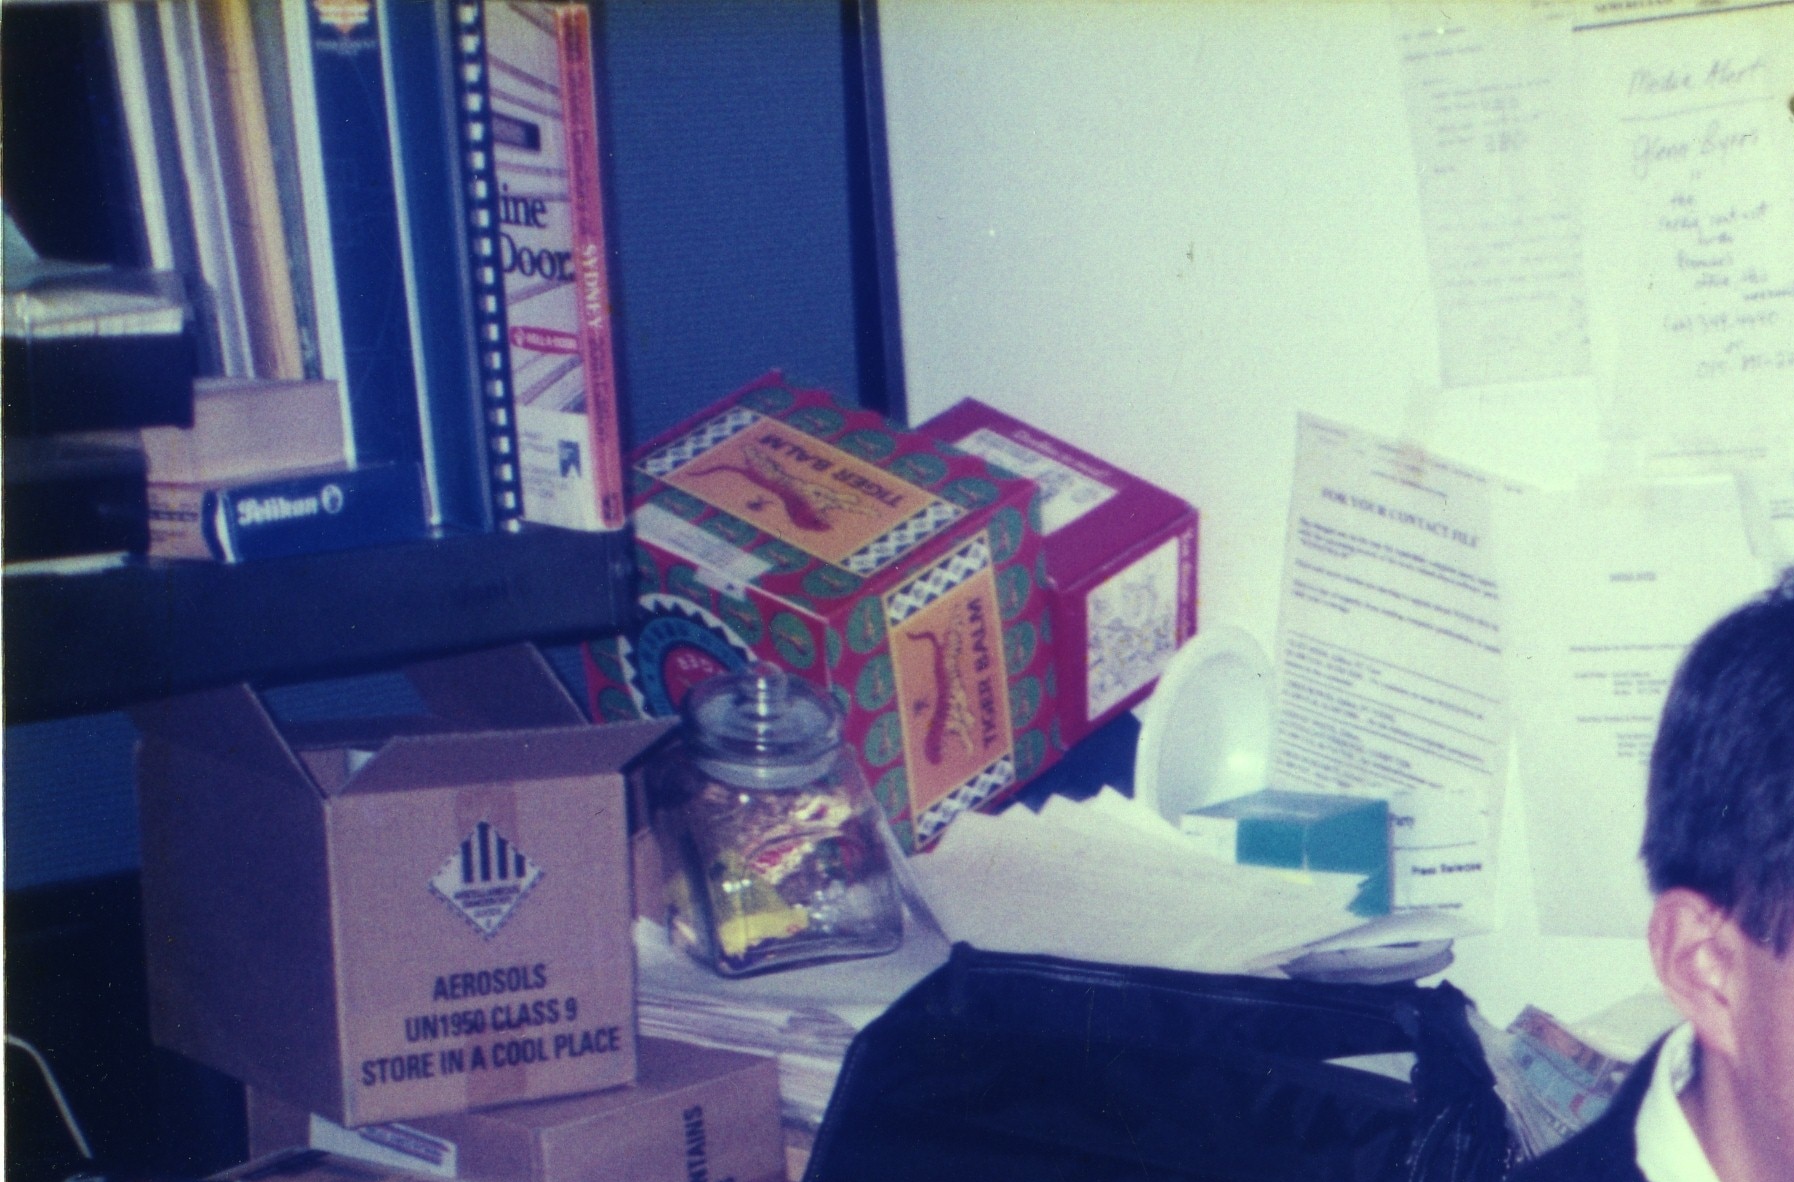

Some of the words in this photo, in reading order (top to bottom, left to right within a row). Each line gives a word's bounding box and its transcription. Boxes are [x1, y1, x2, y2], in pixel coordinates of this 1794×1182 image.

[582, 243, 601, 331] SYDNEY
[759, 433, 834, 473] BALM
[831, 468, 907, 509] TIGER
[967, 597, 992, 674] BALM
[976, 677, 997, 749] TIGER
[432, 963, 548, 1002] AEROSOLS
[404, 1009, 487, 1043] UN1950
[490, 998, 561, 1032] CLASS
[563, 996, 578, 1022] 9
[361, 1052, 435, 1087] STORE
[440, 1047, 464, 1075] IN
[471, 1045, 486, 1071] A
[491, 1037, 549, 1069] COOL
[553, 1026, 620, 1060] PLACE
